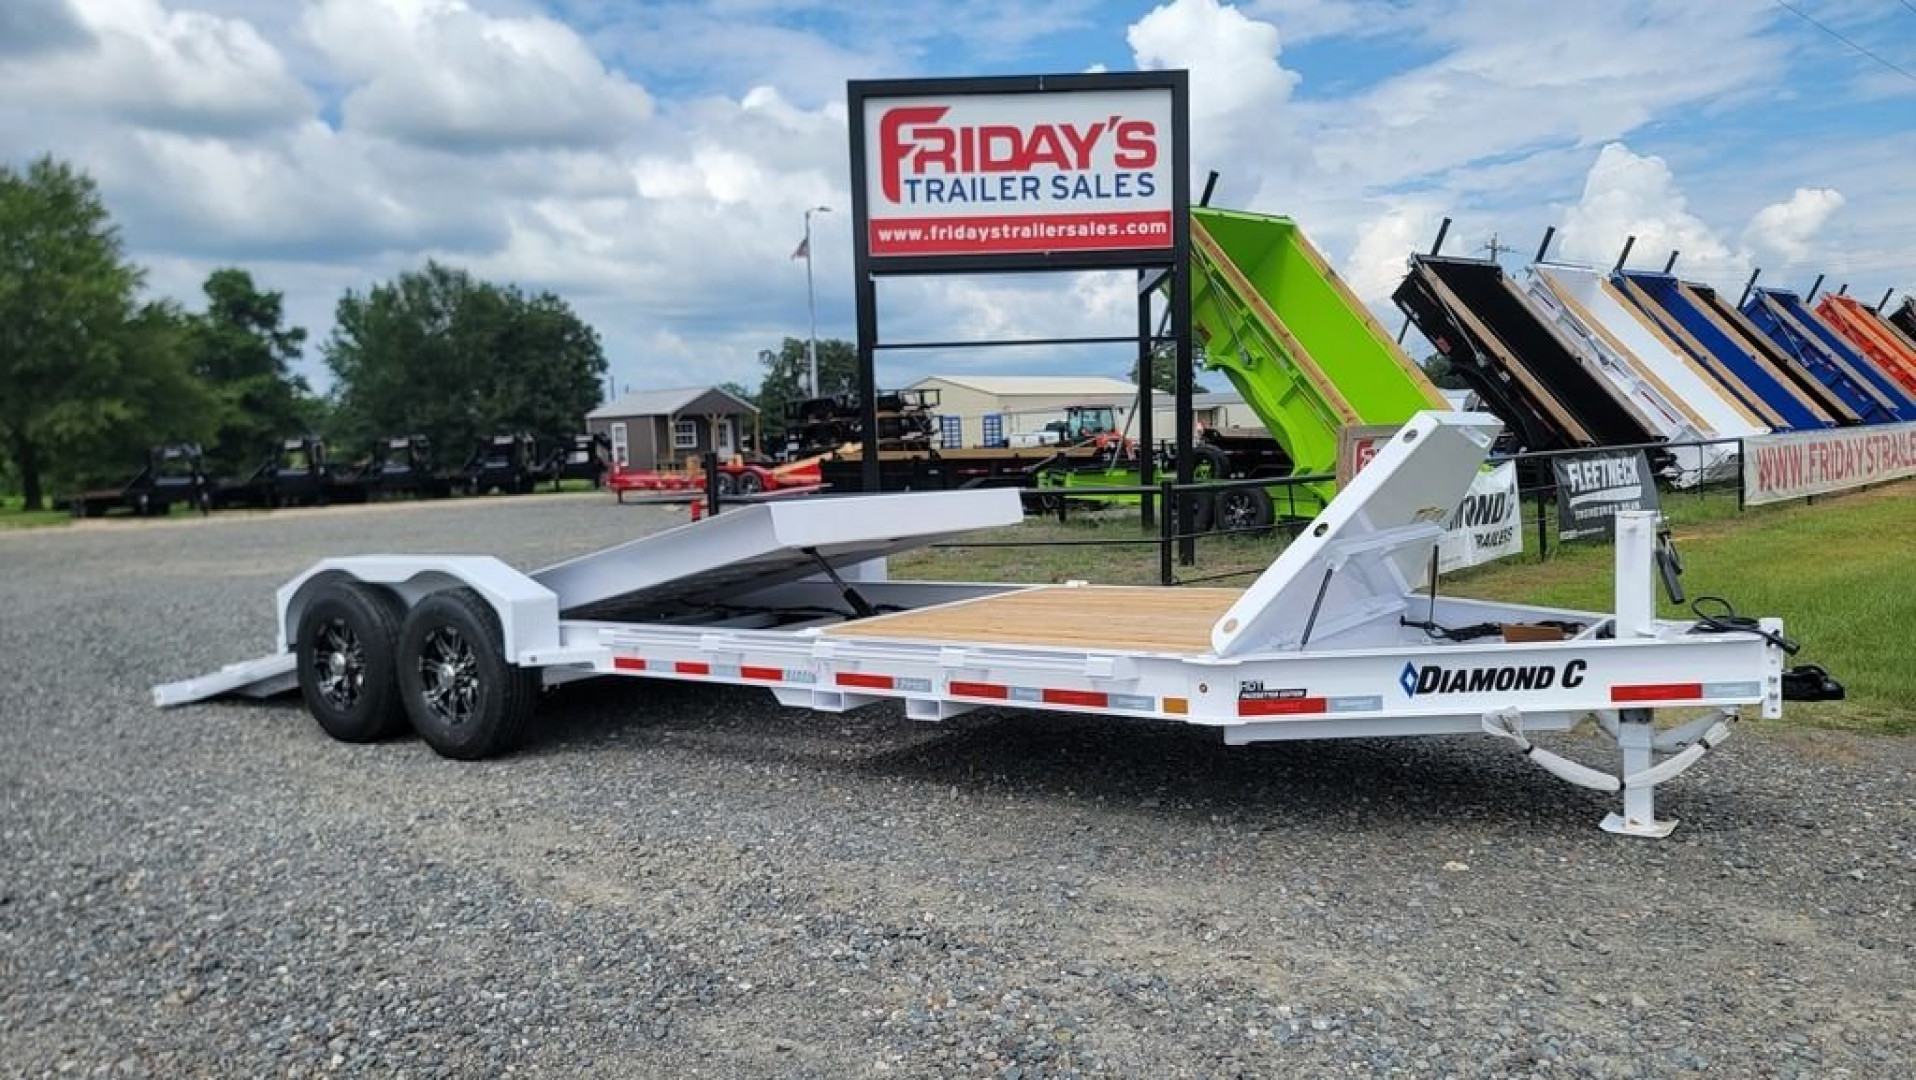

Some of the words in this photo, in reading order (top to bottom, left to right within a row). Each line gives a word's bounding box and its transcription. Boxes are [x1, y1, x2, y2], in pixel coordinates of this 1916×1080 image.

[880, 105, 1158, 205] FRIDAY'S
[904, 175, 1041, 203] TRAILER
[1051, 171, 1155, 200] SALES
[877, 218, 1167, 242] www.fridaystrailersales.com
[1566, 456, 1641, 493] FLEETNECK
[1415, 665, 1556, 695] DIAMOND
[1561, 658, 1588, 689] C
